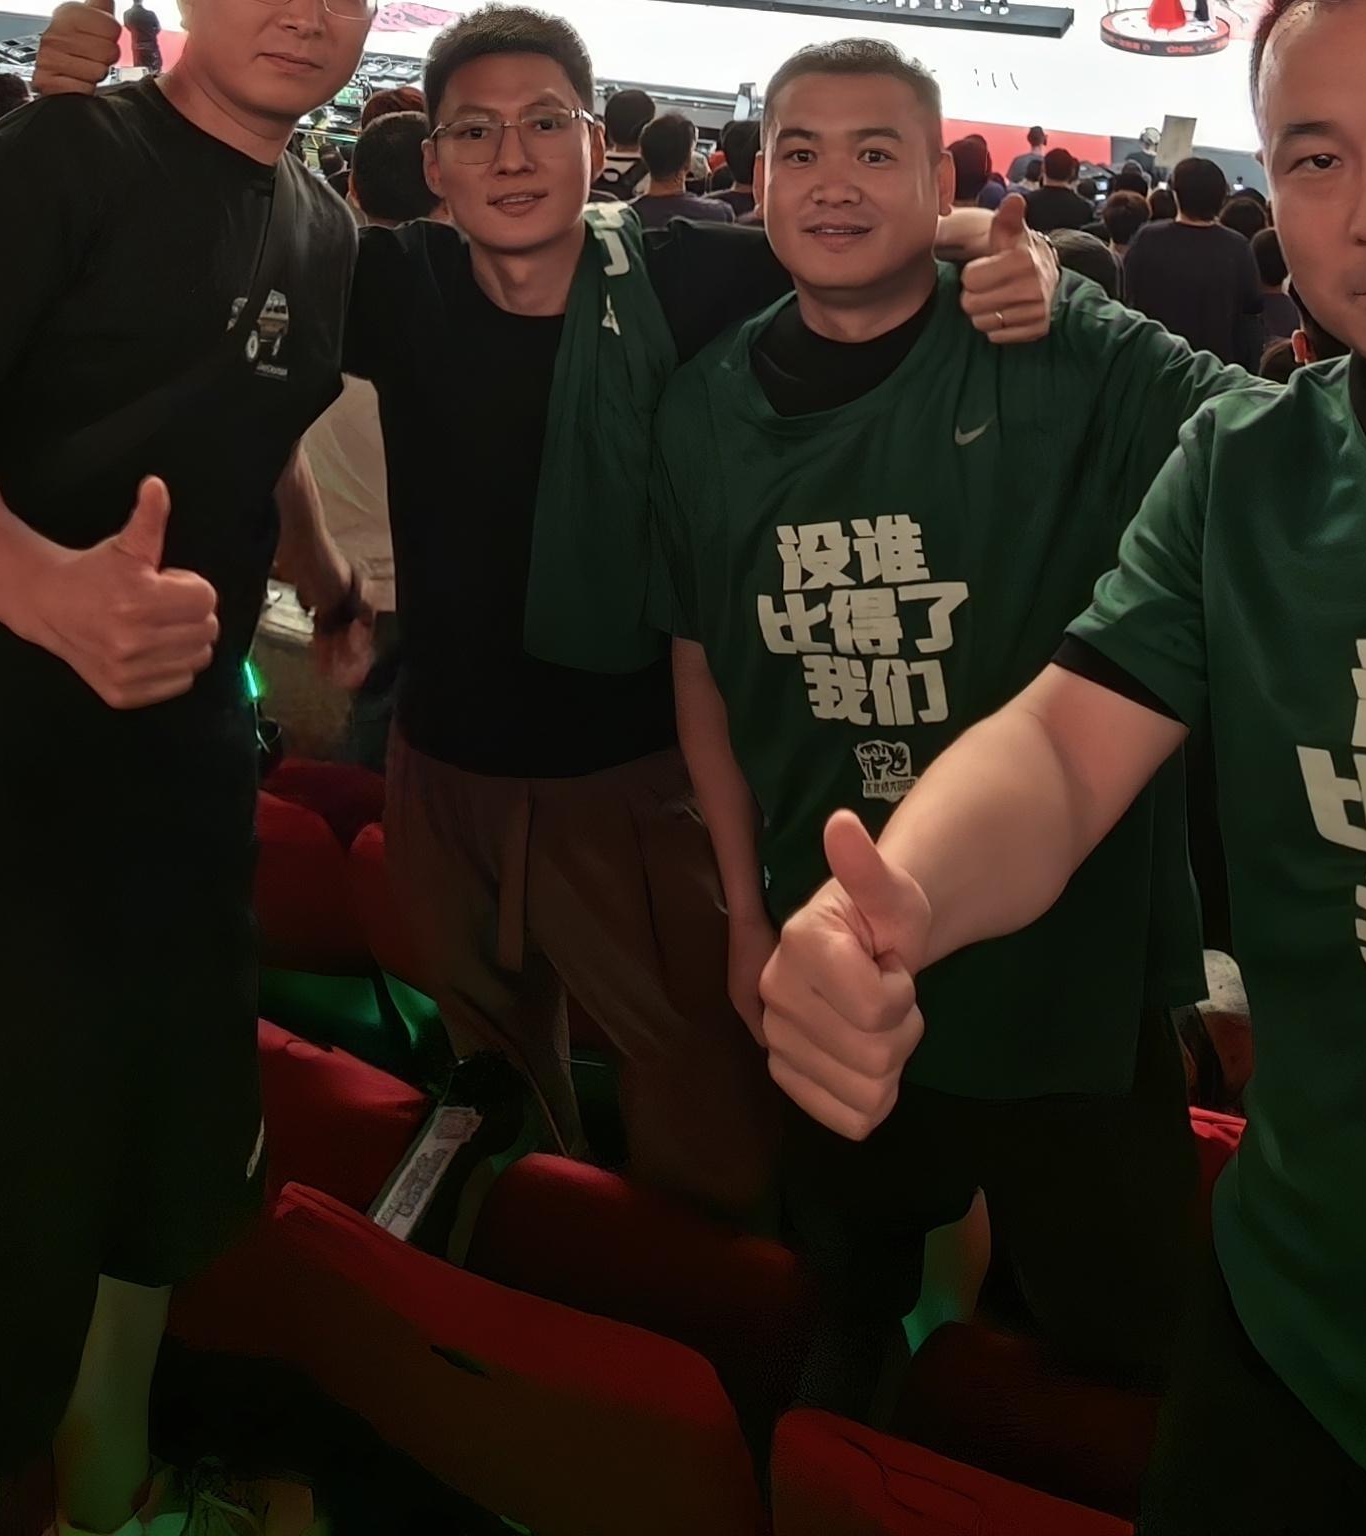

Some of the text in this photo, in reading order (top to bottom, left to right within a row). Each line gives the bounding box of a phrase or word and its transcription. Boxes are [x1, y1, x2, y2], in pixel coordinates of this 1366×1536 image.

[776, 514, 930, 591] 没谁
[757, 581, 969, 655] 比得了
[802, 655, 948, 726] 我们
